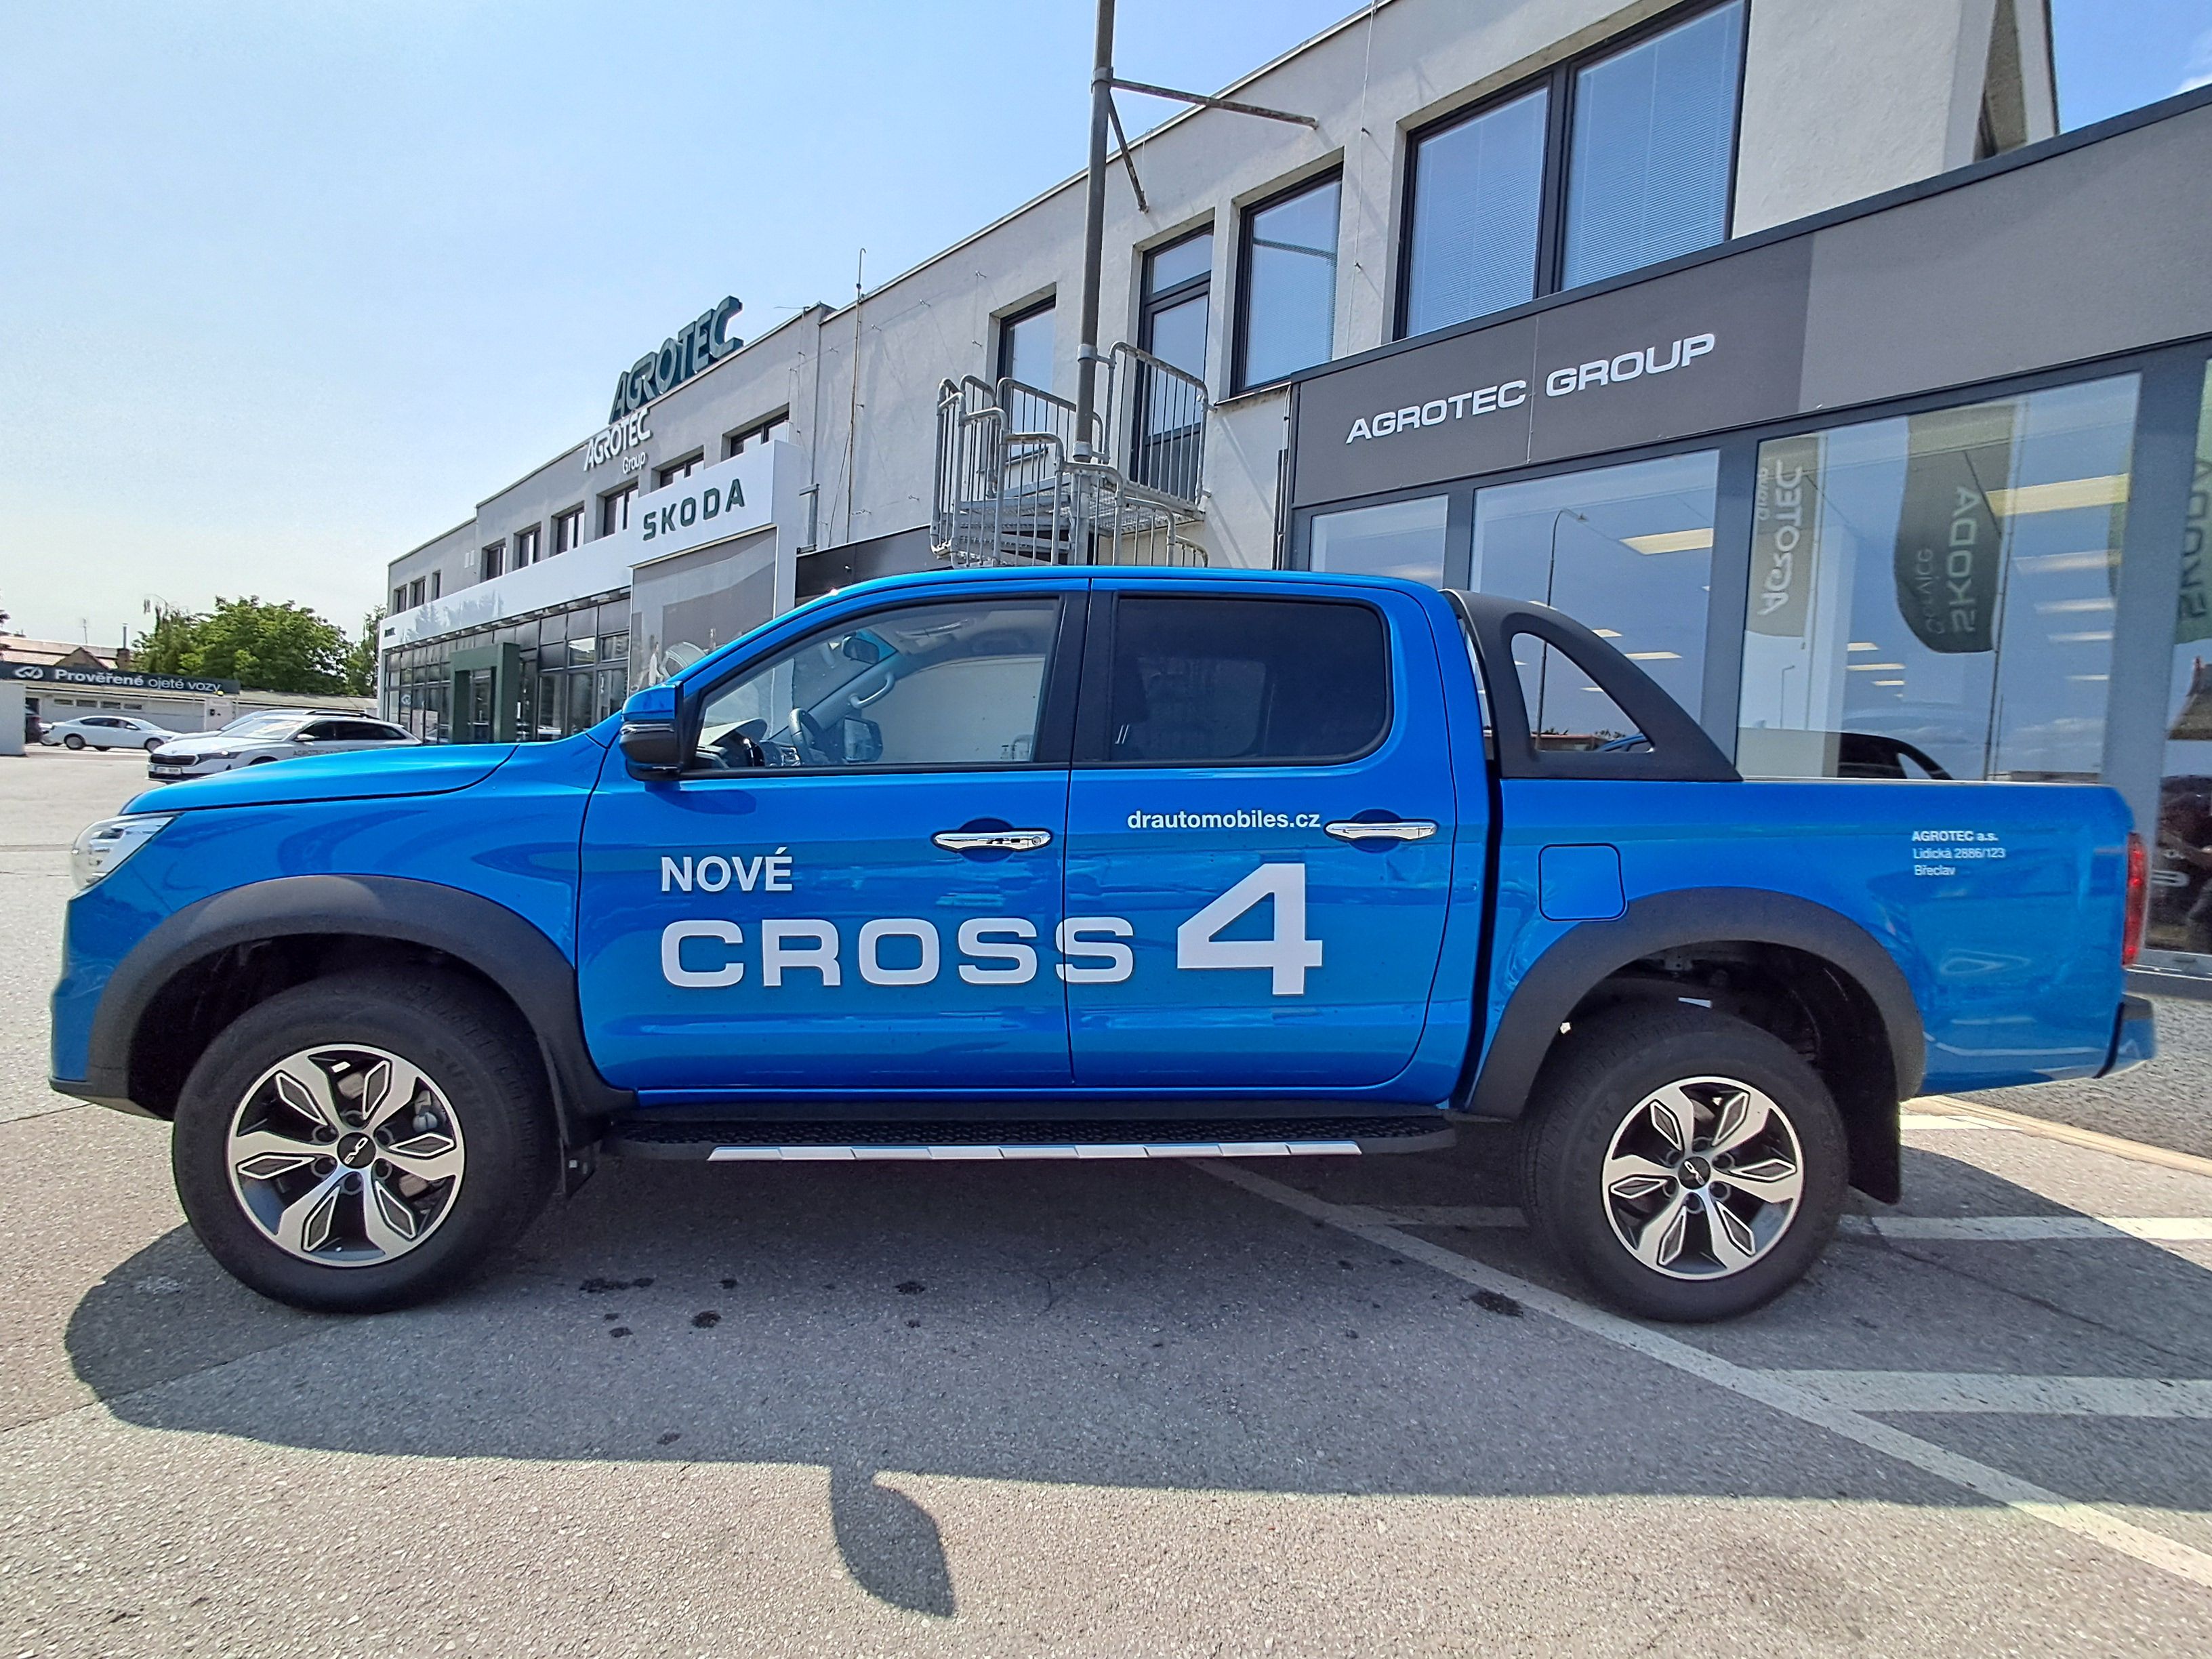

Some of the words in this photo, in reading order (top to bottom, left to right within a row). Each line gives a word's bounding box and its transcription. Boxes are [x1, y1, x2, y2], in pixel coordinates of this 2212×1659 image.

[609, 295, 744, 424] AGROTEC
[1345, 380, 1527, 445] AGROTEC
[1545, 333, 1716, 397] GROUP
[583, 408, 652, 472] AGROTEC
[622, 451, 647, 474] Group
[54, 668, 144, 687] Prověřené
[148, 677, 184, 690] ojeté
[188, 682, 221, 693] vozy
[1126, 809, 1321, 830] drautomobiles.cz
[1912, 831, 1974, 841] AGROTEC
[1977, 832, 1999, 841] a.s.
[1912, 848, 1952, 859] Lidická
[1954, 848, 2006, 859] 2886/123
[661, 847, 793, 892] NOVÉ
[1914, 865, 1956, 876] Břeclav
[661, 916, 1134, 987] CROSS
[1176, 862, 1324, 996] 4
